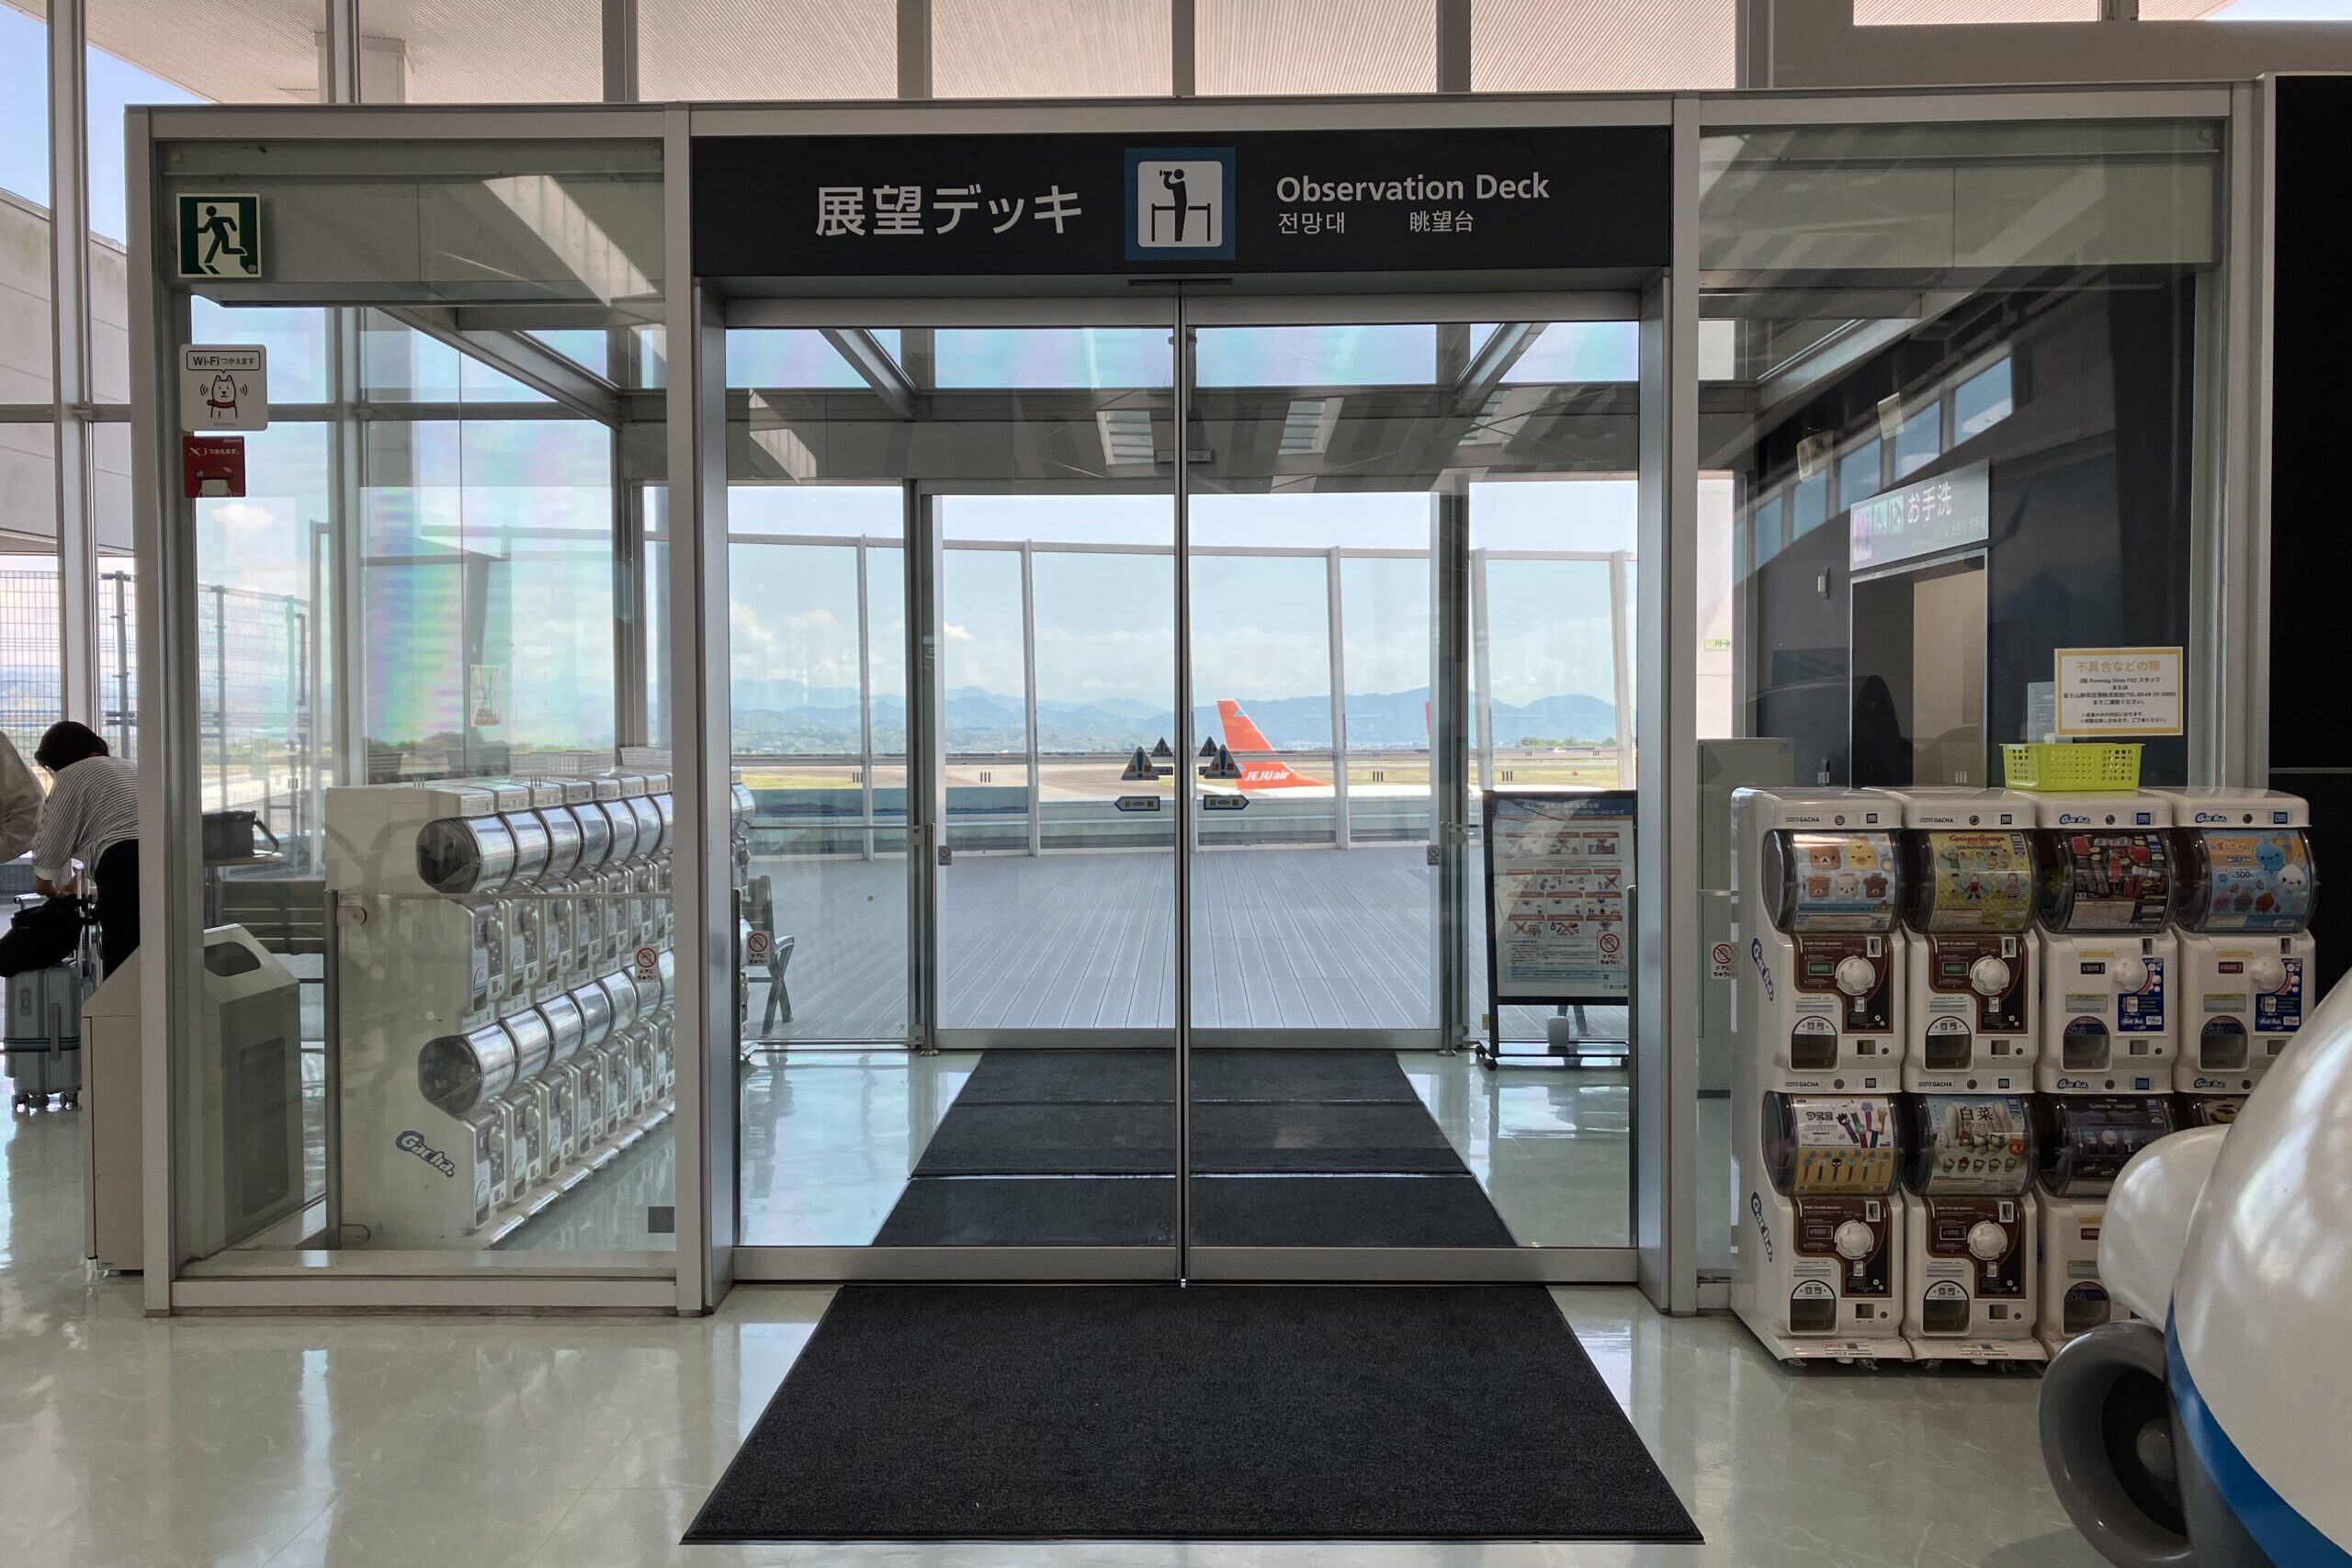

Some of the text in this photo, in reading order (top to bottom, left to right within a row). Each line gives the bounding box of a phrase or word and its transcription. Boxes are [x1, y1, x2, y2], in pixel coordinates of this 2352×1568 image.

[1276, 171, 1551, 203] Observation Deck
[815, 183, 1082, 237] 展望デッキ
[1409, 209, 1475, 233] 眺望台
[1278, 211, 1346, 235] 전망대
[1960, 1106, 1994, 1122] 白菜
